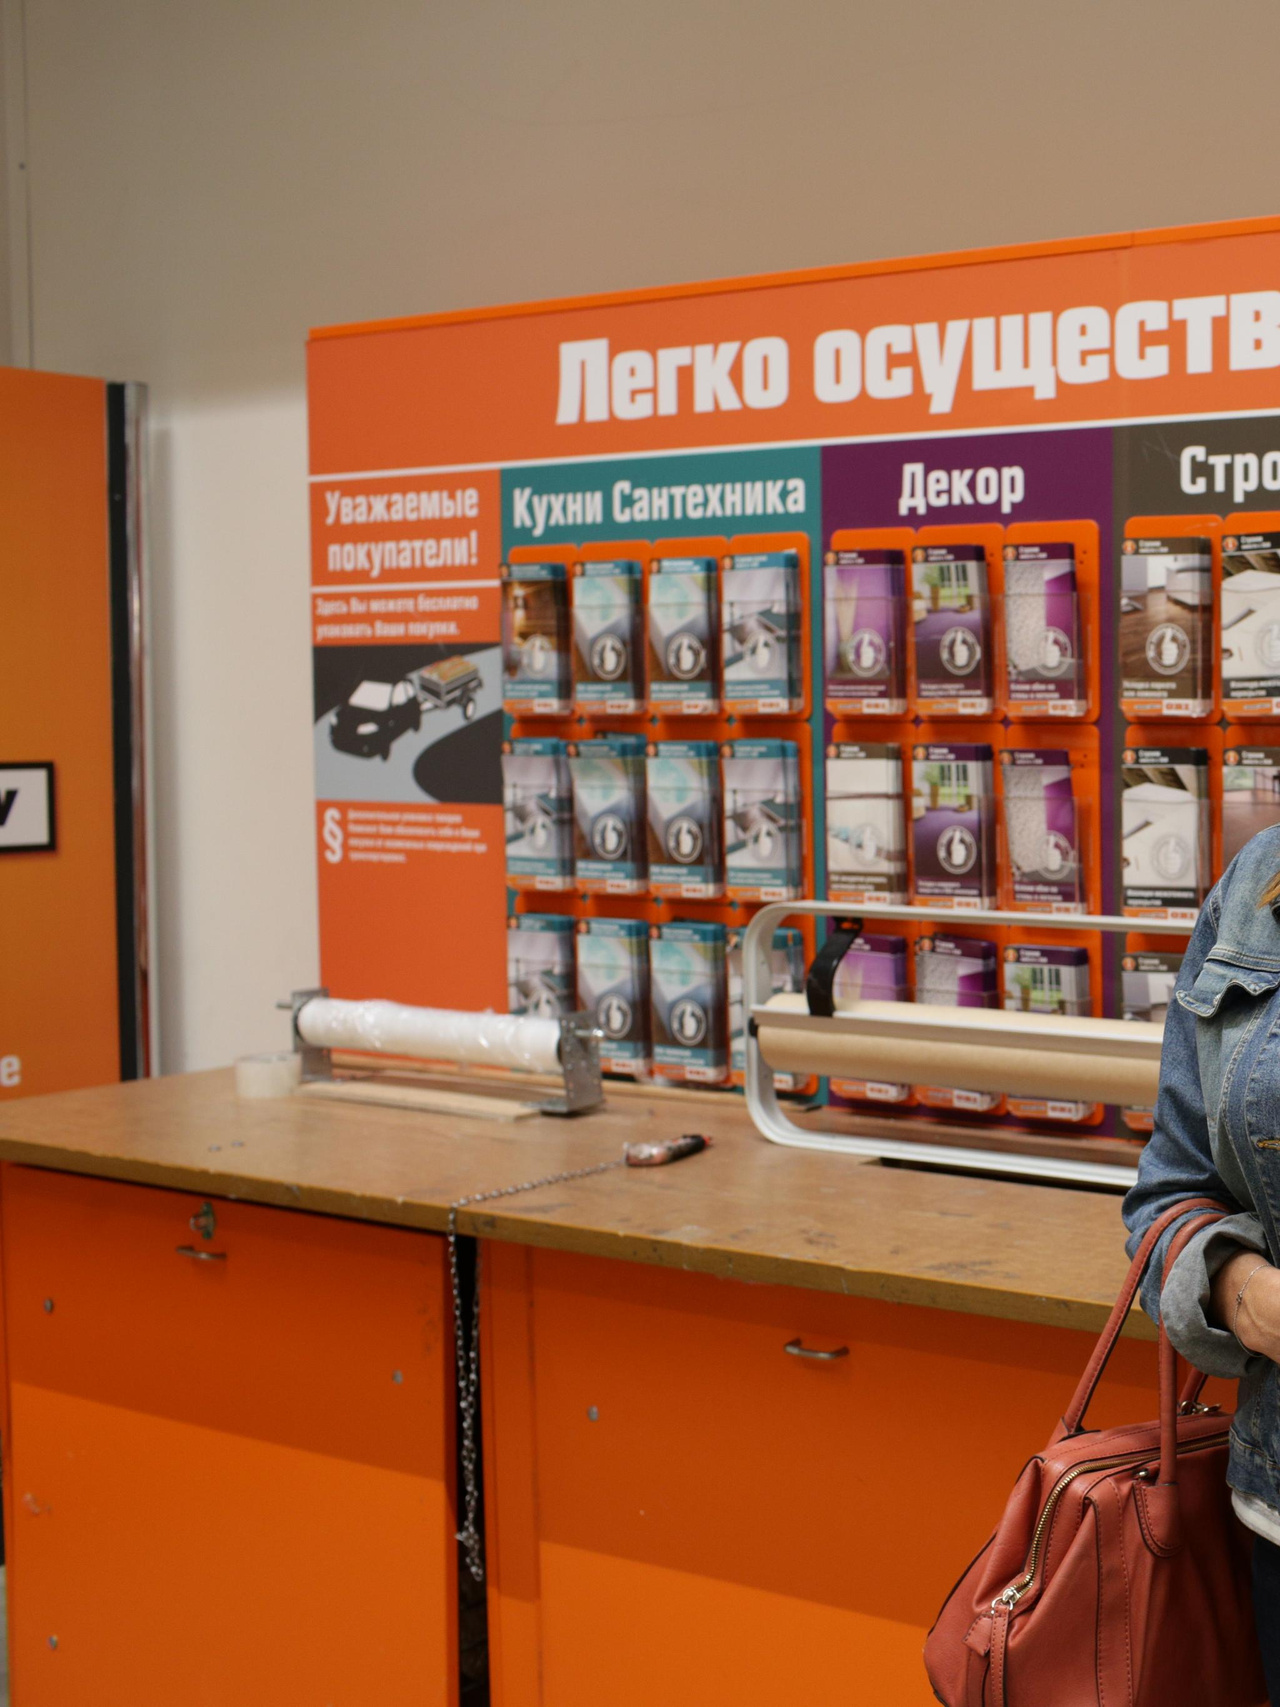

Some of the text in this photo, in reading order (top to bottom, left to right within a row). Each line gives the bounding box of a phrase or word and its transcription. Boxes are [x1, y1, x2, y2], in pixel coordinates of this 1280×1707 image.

[555, 337, 789, 425] Легко
[325, 487, 480, 526] Уважаемые
[512, 477, 806, 538] Кухни Сантехника
[899, 462, 1026, 516] Декор
[327, 530, 479, 579] покупатели!
